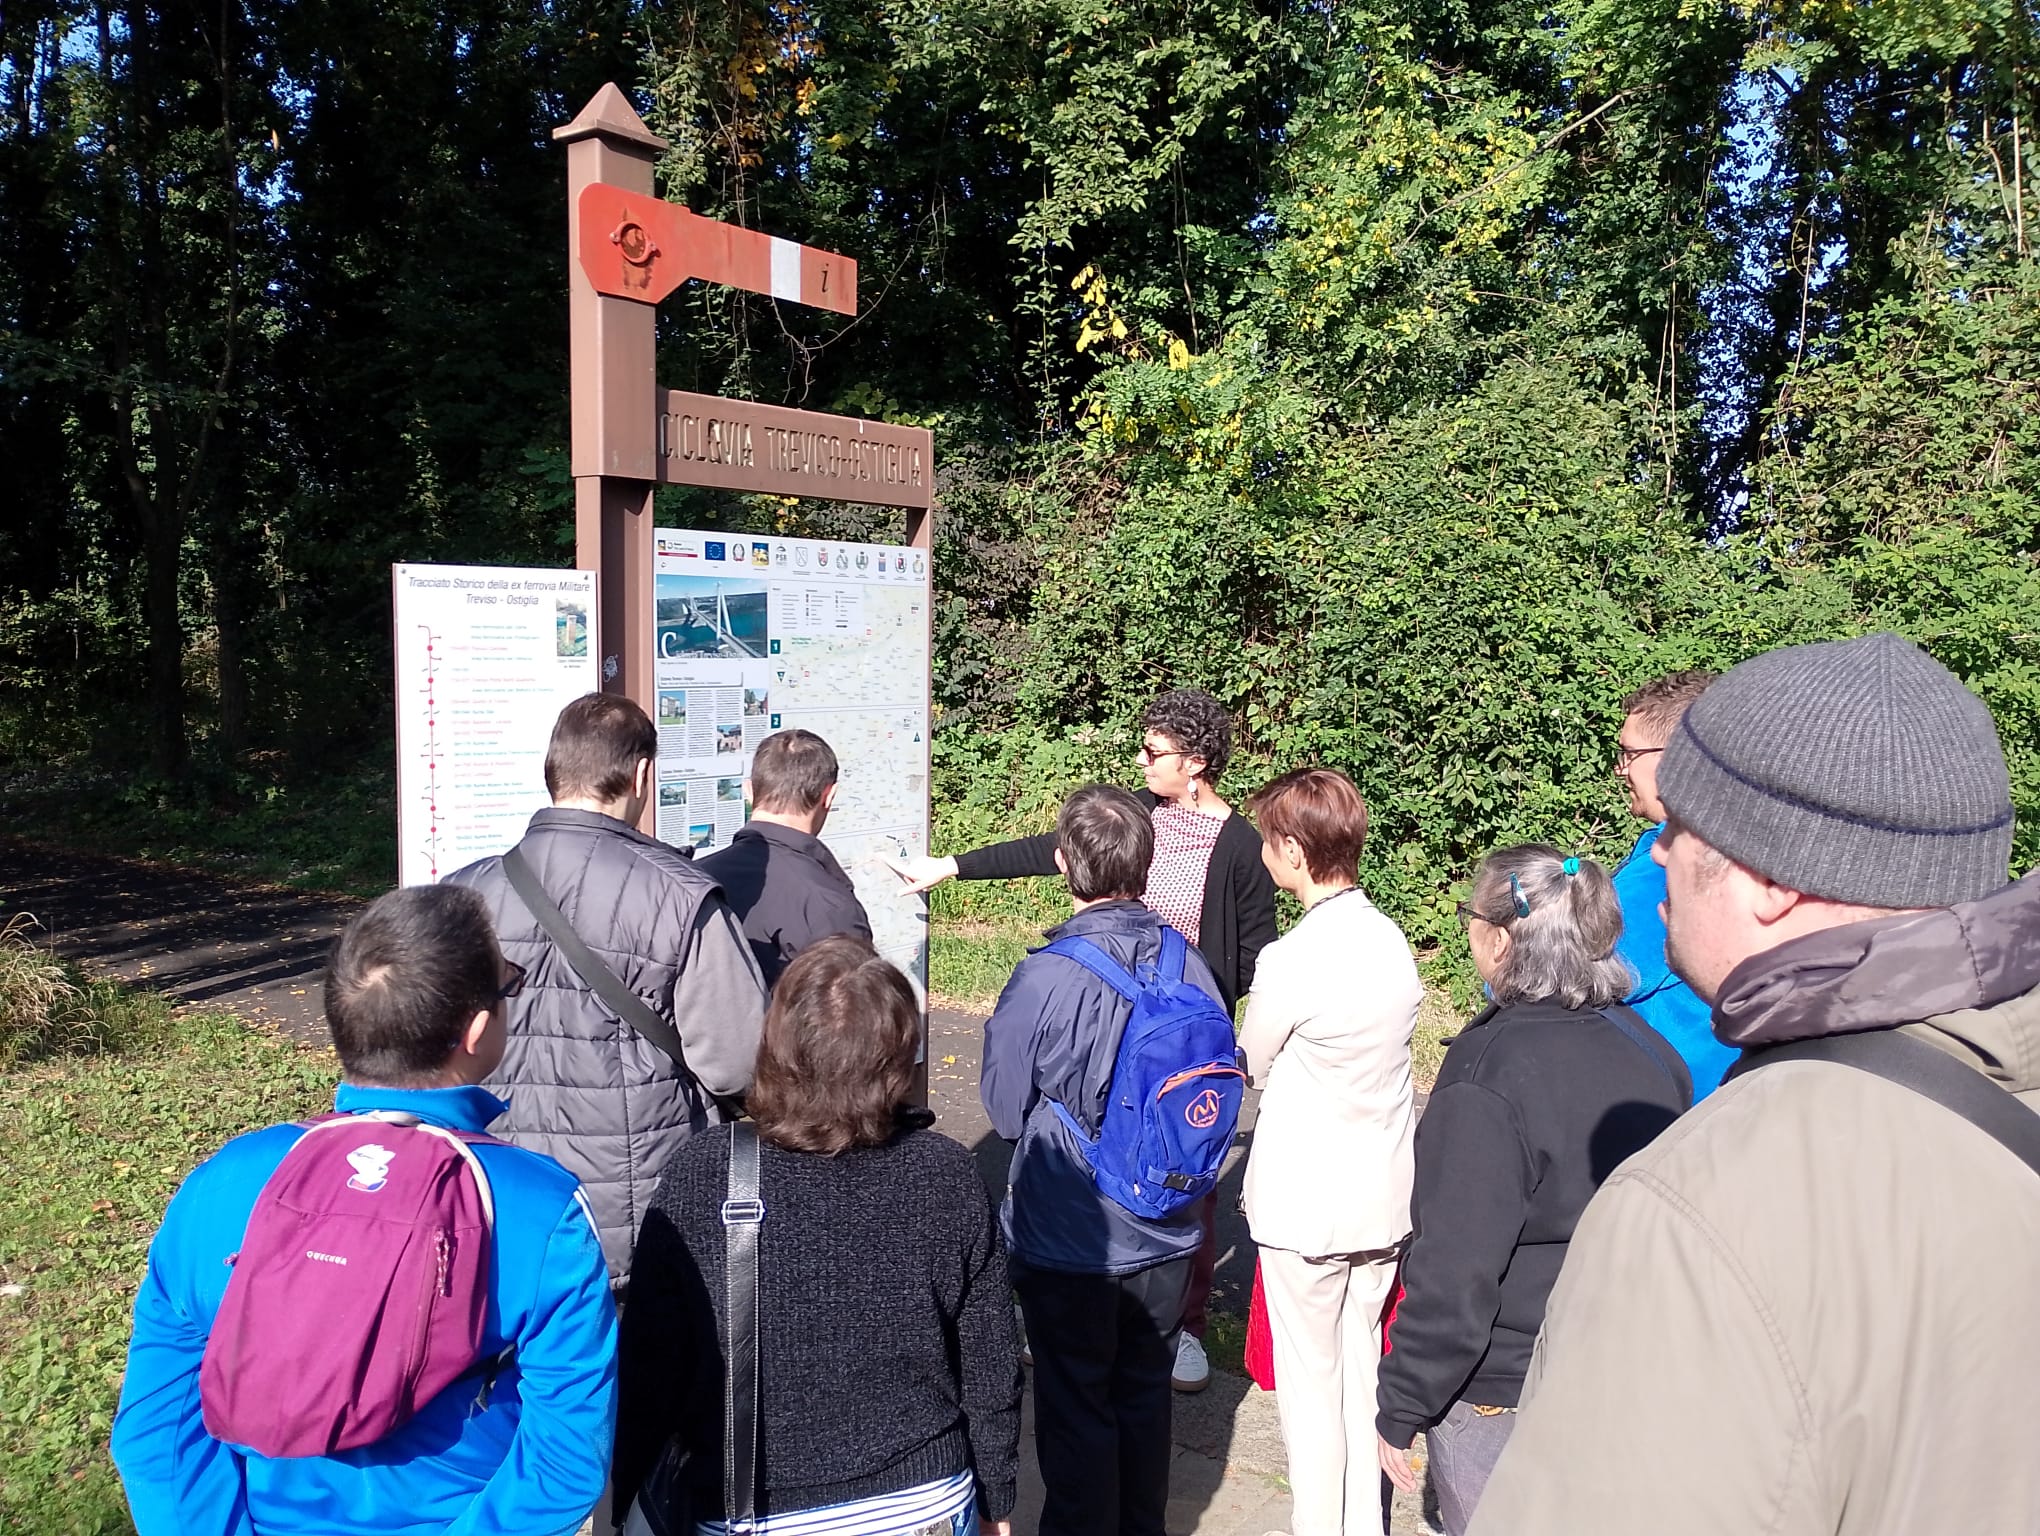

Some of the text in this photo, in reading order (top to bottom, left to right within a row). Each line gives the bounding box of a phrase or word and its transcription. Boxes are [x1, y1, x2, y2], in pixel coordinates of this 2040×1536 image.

[821, 263, 829, 293] i
[660, 412, 922, 487] CICLOVIA TREVISO-OSTIGLIA
[409, 576, 590, 592] Tracciato Storico della ex ferrovia Militare
[466, 594, 497, 604] Treviso
[506, 594, 539, 607] Ostiglia
[306, 1250, 347, 1266] QUECHUA
